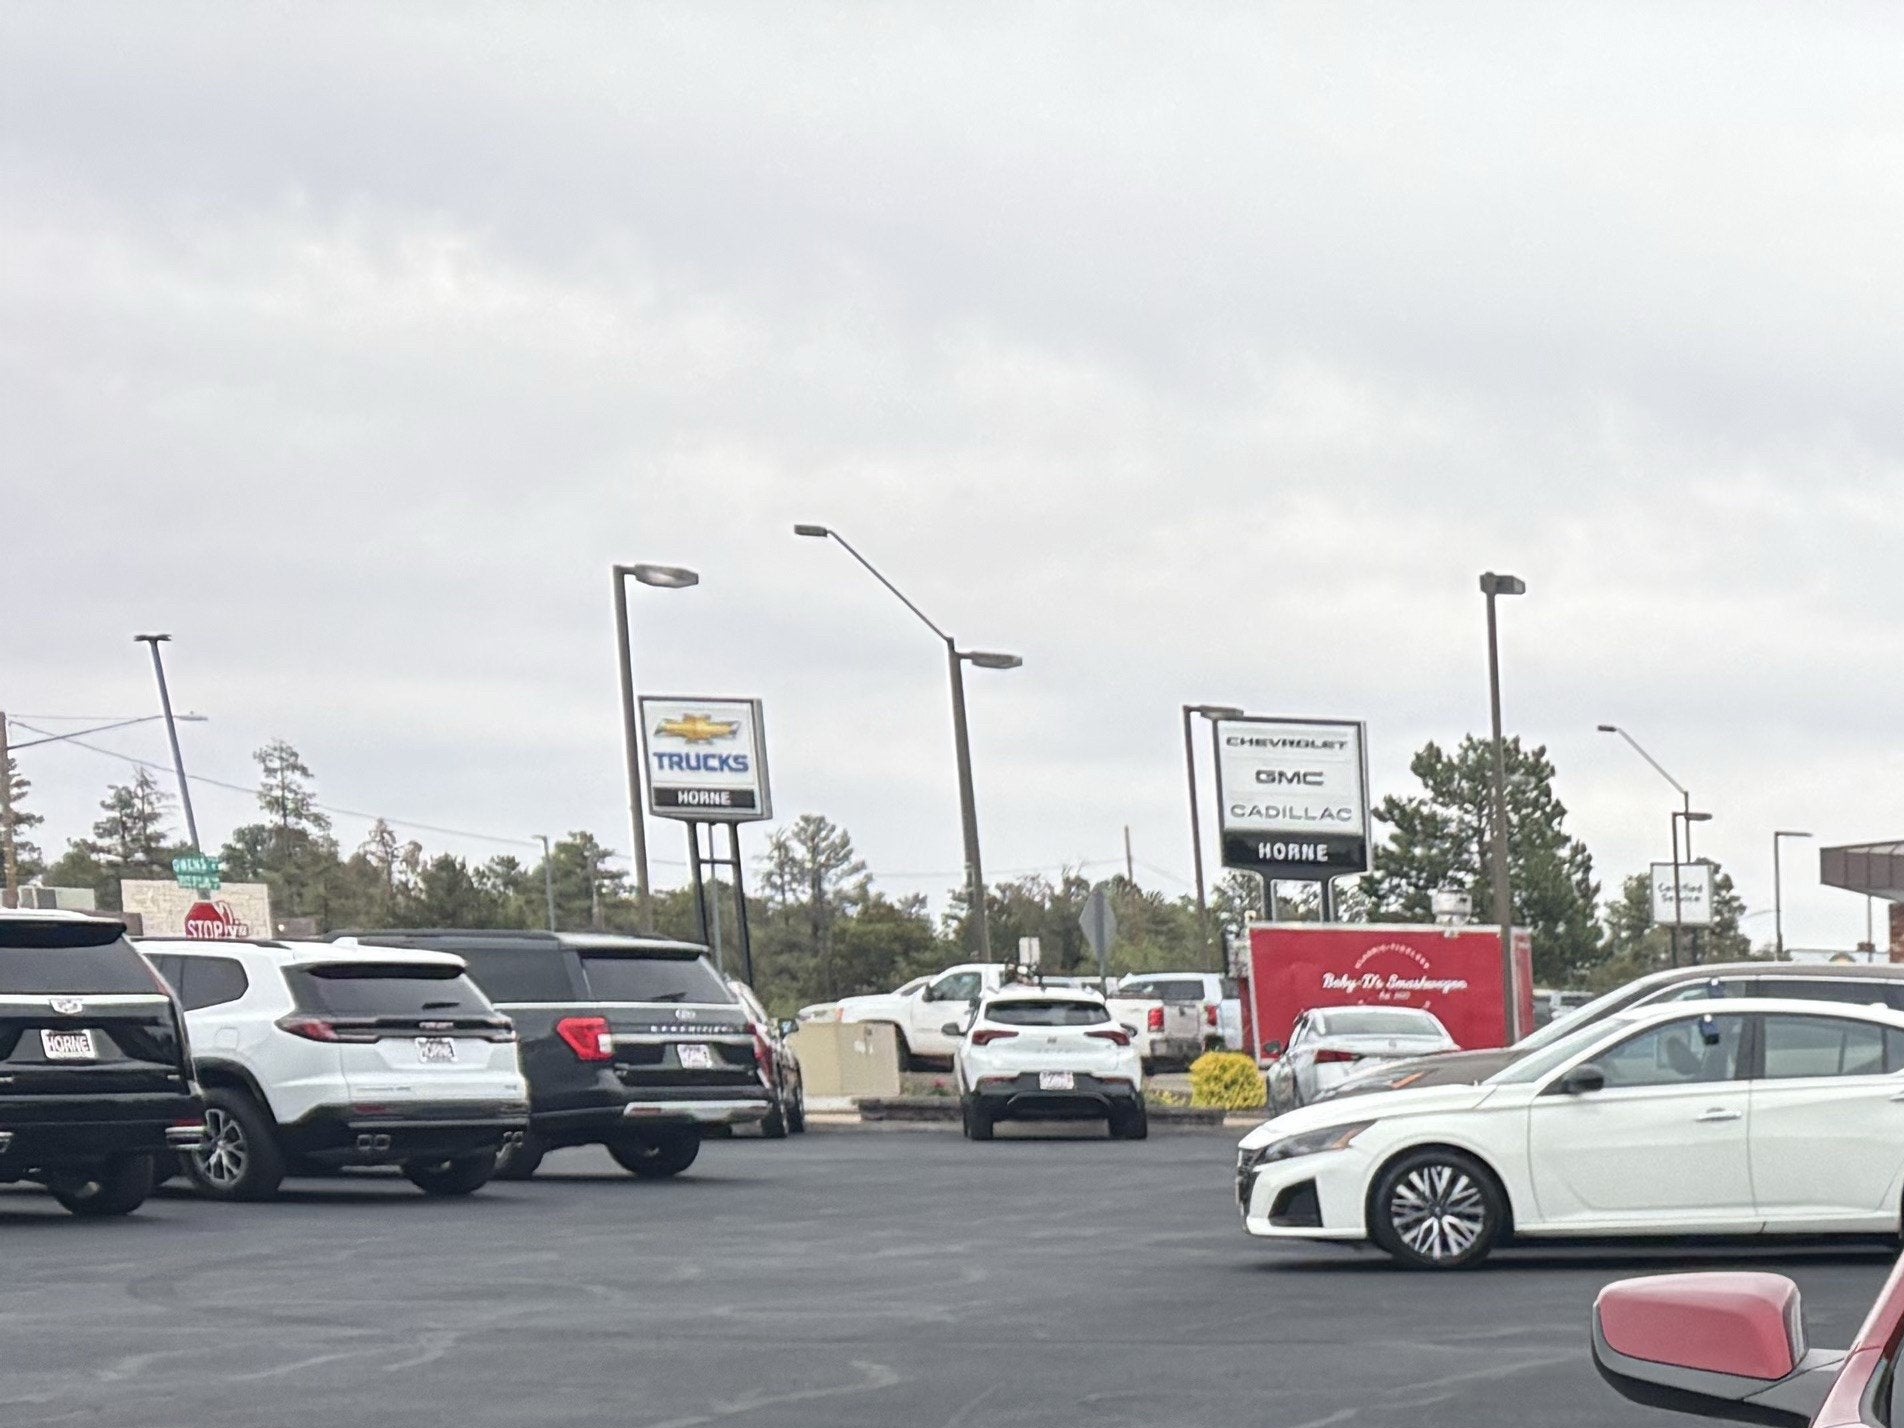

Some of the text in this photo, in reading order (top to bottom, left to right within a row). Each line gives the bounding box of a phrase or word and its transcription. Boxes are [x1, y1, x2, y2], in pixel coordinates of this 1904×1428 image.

[1226, 736, 1348, 750] CHEVROLET
[652, 752, 749, 773] TRUCKS
[1255, 769, 1325, 786] GMC
[677, 790, 732, 806] HORNE
[1230, 804, 1353, 822] CADILLAC
[1258, 842, 1329, 863] HORNE
[187, 920, 223, 939] STOP
[46, 1035, 91, 1052] HORNE
